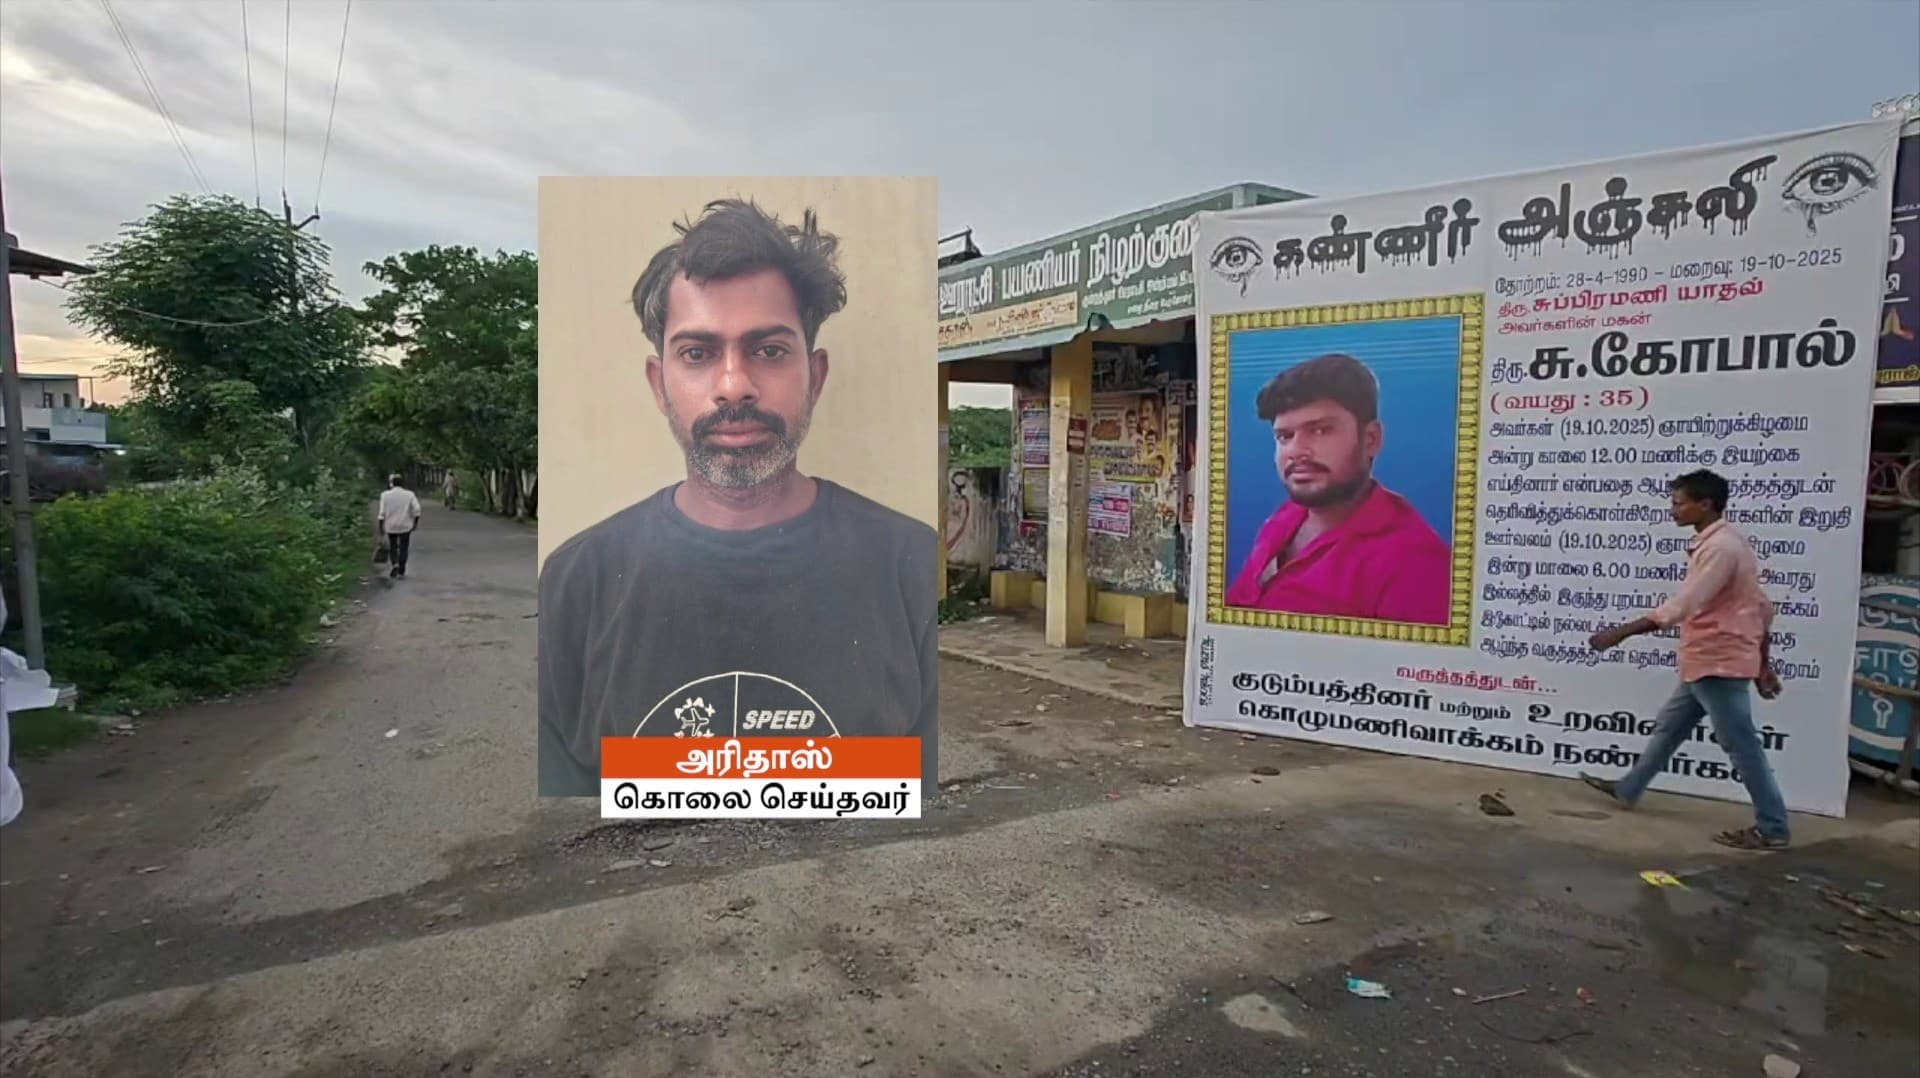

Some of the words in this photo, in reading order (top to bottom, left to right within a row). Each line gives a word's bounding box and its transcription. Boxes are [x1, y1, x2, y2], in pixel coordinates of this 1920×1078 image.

[1273, 198, 1480, 281] கண்ணீர்
[1497, 155, 1778, 262] அஞ்சலி
[1002, 240, 1081, 300] பயணியர்
[1566, 266, 1648, 288] 28-4-1990
[1740, 248, 1842, 273] 19-10-2025
[1678, 276, 1764, 304] யாதவ்
[1498, 315, 1597, 335] அவர்களின்
[1601, 311, 1652, 328] மகன்
[1529, 318, 1856, 381] சு.கோபால்
[1489, 417, 1554, 437] அவர்கள்
[1560, 415, 1654, 441] (19.10.2025)
[1659, 411, 1808, 439] ஞாயிற்றுக்கிழமை
[1488, 445, 1534, 470] அன்று
[1538, 450, 1587, 464] காலை
[1591, 447, 1637, 464] 12.00
[1641, 443, 1717, 466] மணிக்கு
[1721, 441, 1800, 466] இயற்கை
[1487, 473, 1559, 496] எய்தினார்
[1562, 473, 1633, 498] என்பதை
[1798, 505, 1852, 531] இறுதி
[1485, 528, 1552, 547] ஊர்வலம்
[1558, 529, 1652, 556] (19.10.2025)
[1487, 555, 1532, 579] இன்று
[1536, 561, 1588, 577] மாலை
[1592, 562, 1631, 578] 6.00
[1757, 568, 1816, 593] அவரது
[1482, 581, 1551, 605] இல்லத்தில்
[1558, 587, 1609, 611] இருந்து
[1480, 634, 1529, 659] ஆழ்ந்த
[1233, 670, 1433, 711] குடும்பத்தினர்
[1440, 696, 1511, 720] மற்றும்
[742, 710, 816, 730] SPEED
[1239, 699, 1545, 757] கொழுமணிவாக்கம்
